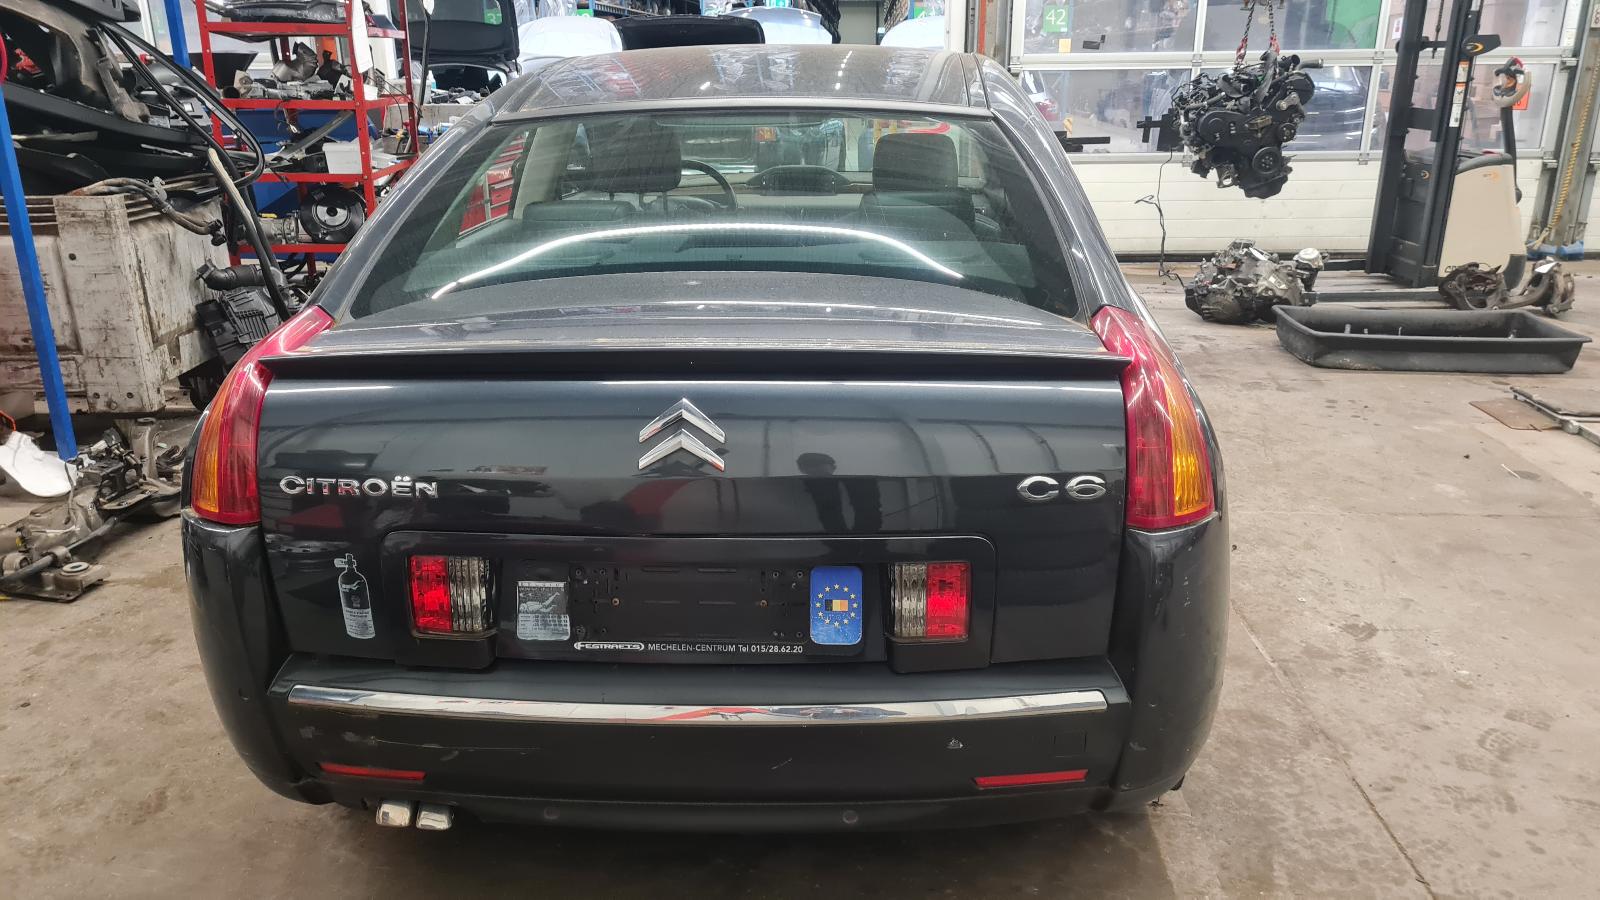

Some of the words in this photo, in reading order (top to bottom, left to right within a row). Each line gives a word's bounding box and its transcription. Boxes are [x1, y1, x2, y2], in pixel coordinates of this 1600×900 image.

[1046, 9, 1066, 25] 42
[280, 475, 438, 498] CITROËN
[1017, 476, 1106, 500] C6
[648, 643, 736, 652] MECHELEN-CENTRUM
[738, 645, 749, 653] Tel
[750, 645, 803, 653] 015/28.62.20
